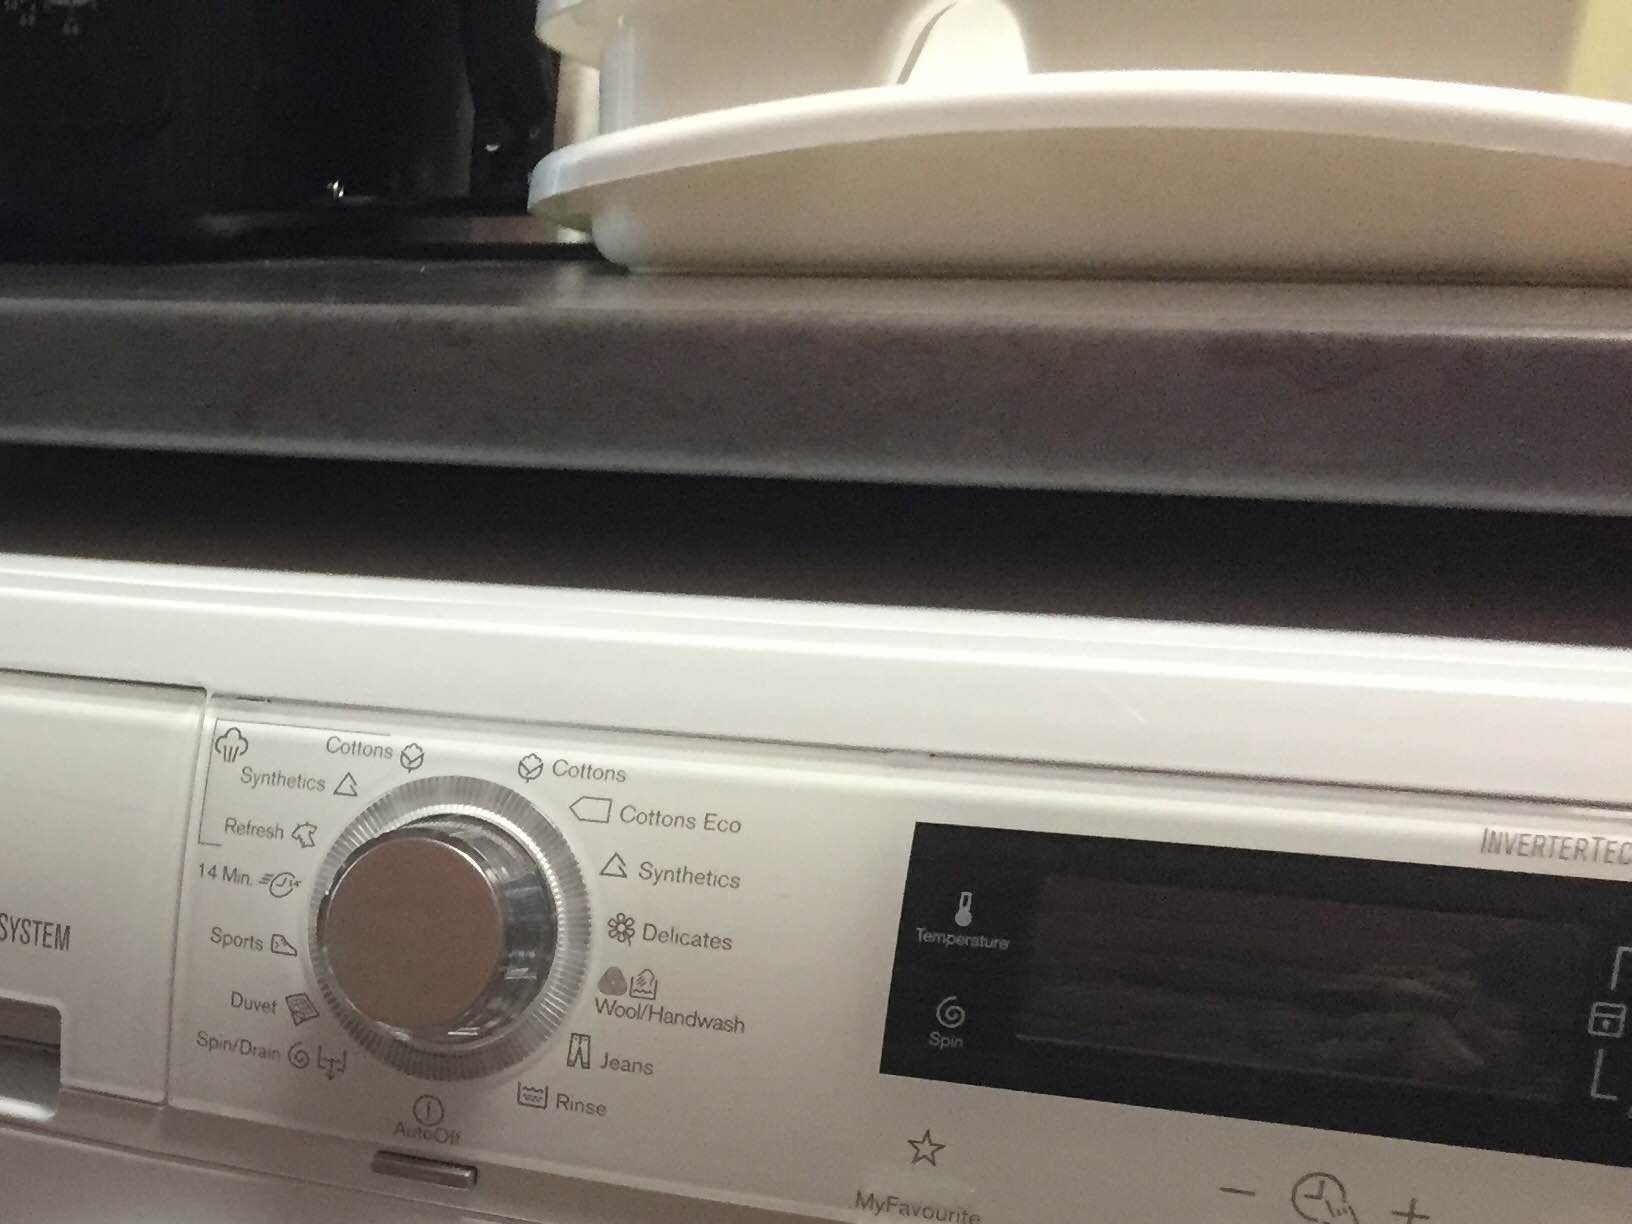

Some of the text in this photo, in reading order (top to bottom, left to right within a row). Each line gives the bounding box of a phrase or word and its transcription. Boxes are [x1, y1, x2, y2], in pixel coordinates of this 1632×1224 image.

[326, 736, 393, 760] Cottons
[240, 766, 326, 793] Synthetics
[552, 758, 626, 783] Cottons
[224, 817, 284, 840] Refresh
[620, 804, 742, 834] Cottons Eco
[199, 863, 253, 886] 14 Min.
[638, 861, 741, 889] Synthetics
[210, 926, 264, 951] Sports
[642, 923, 733, 951] Delicates
[916, 927, 1010, 950] Temperature
[231, 991, 277, 1014] Duvet
[595, 997, 745, 1034] Wool/Handwash
[196, 1030, 281, 1060] Spin/Drain
[929, 1031, 964, 1051] Spin
[600, 1052, 654, 1075] Jeans
[556, 1093, 607, 1116] Rinse
